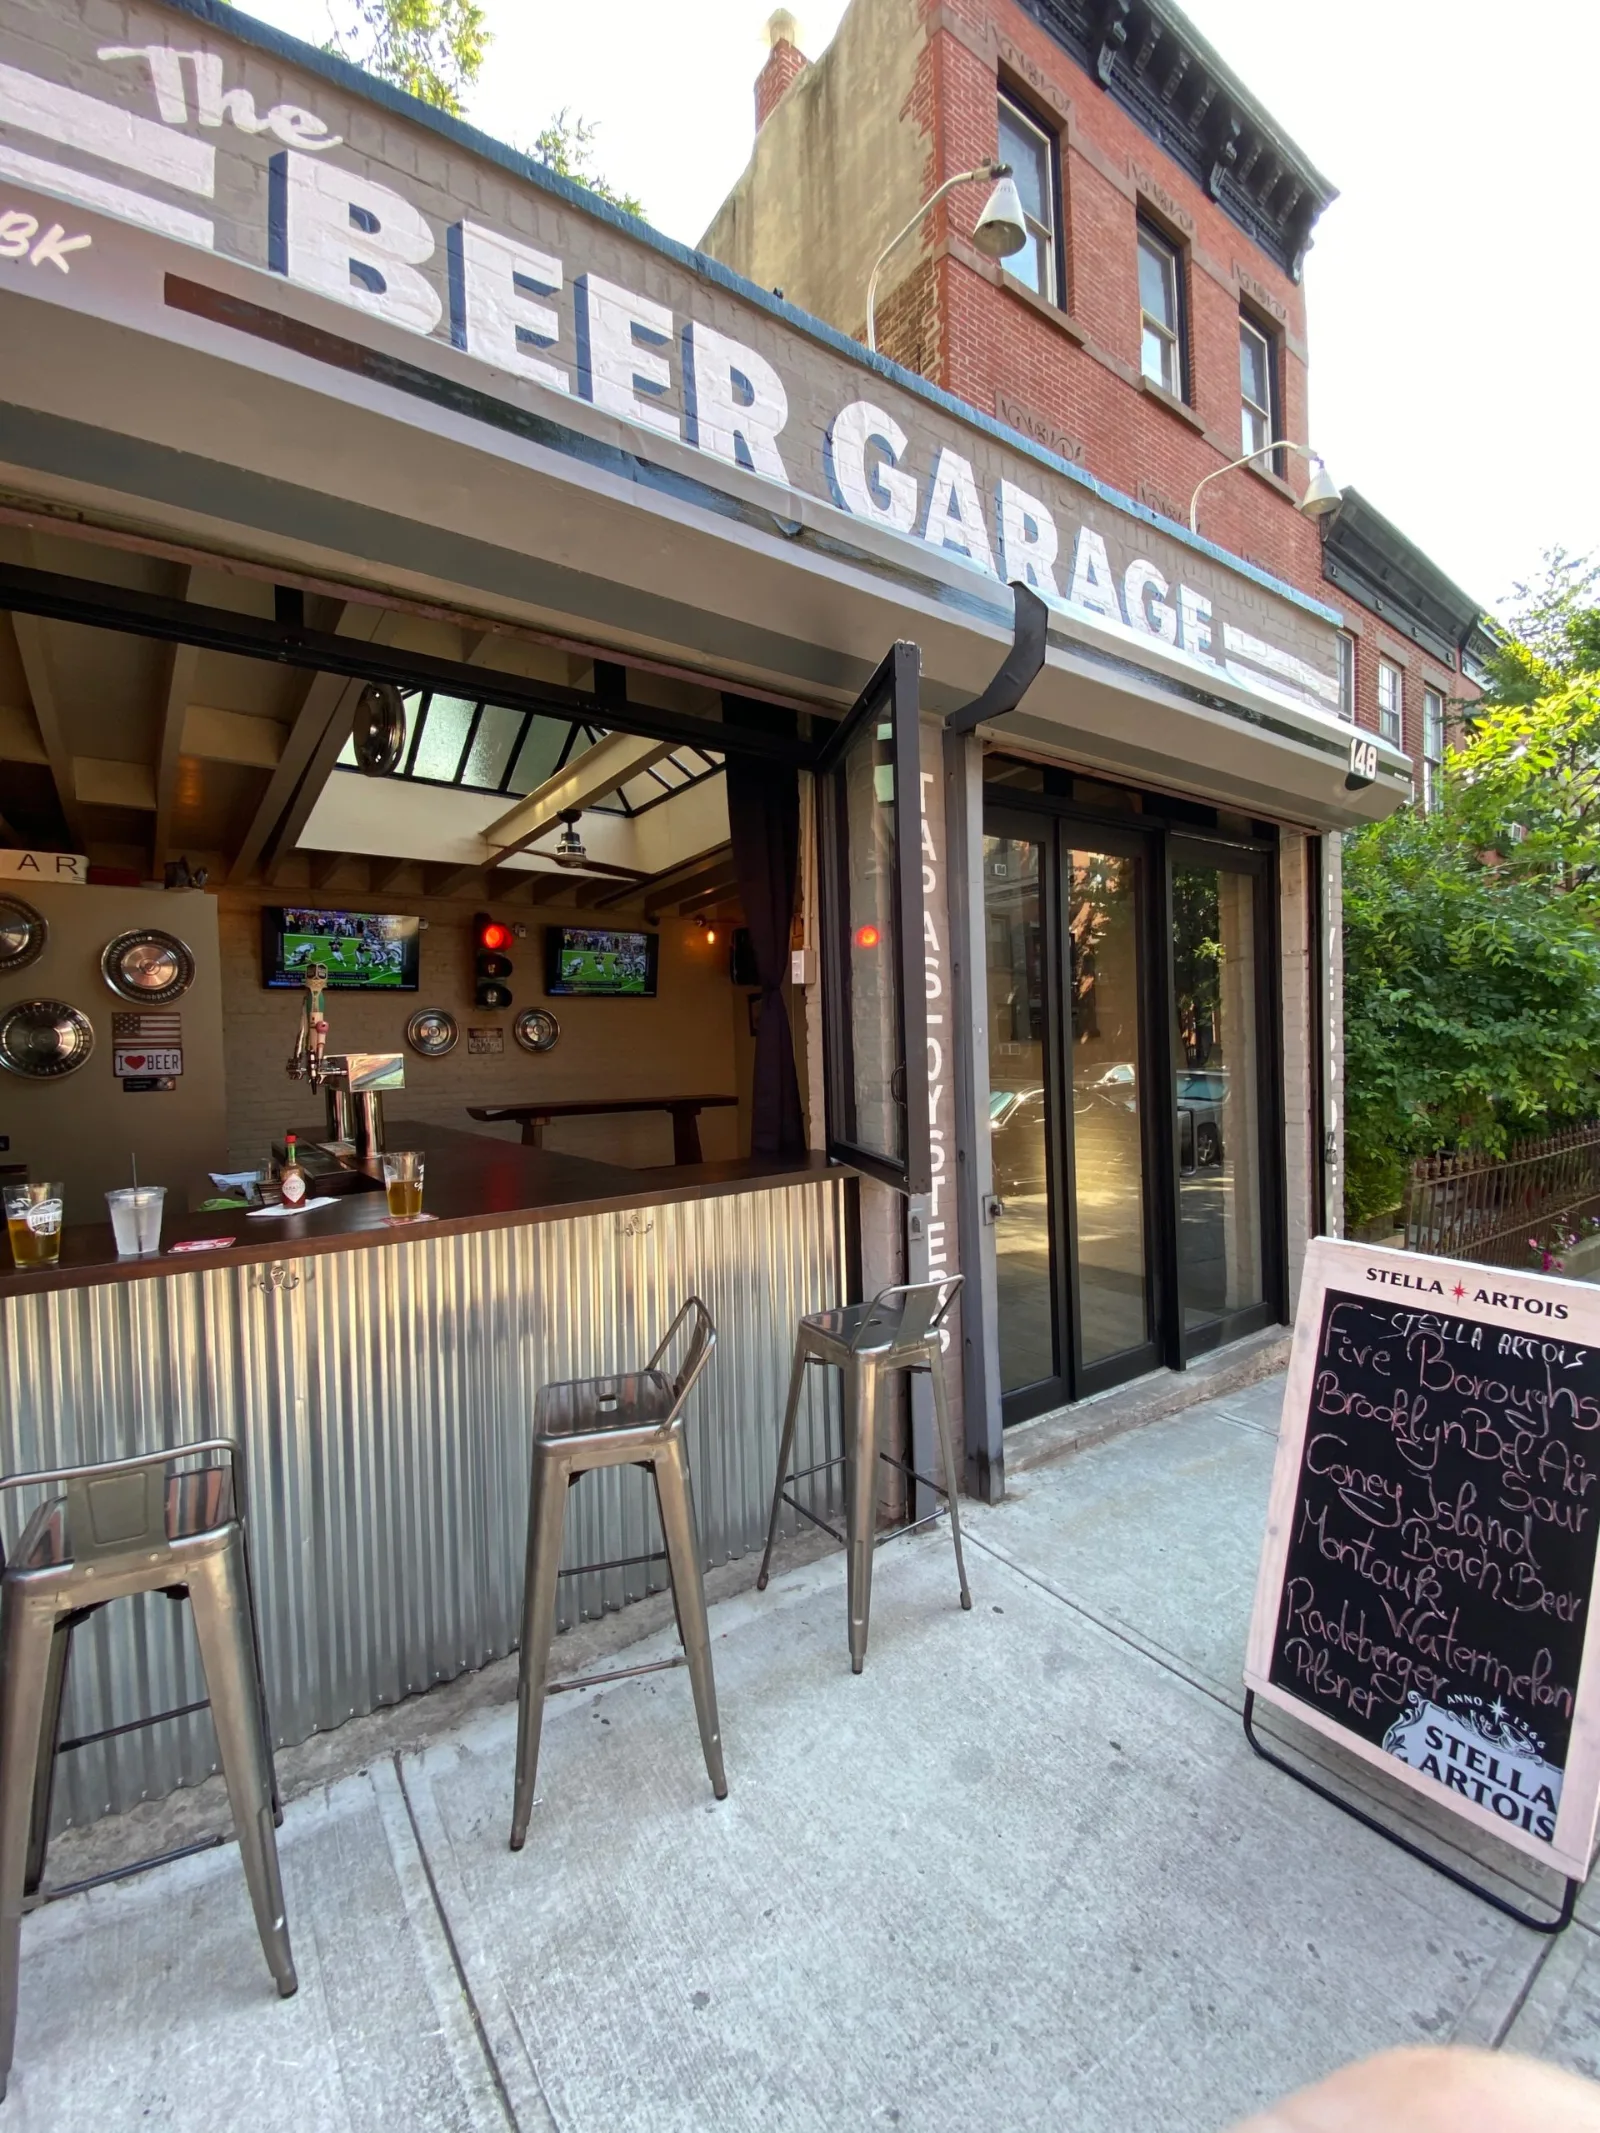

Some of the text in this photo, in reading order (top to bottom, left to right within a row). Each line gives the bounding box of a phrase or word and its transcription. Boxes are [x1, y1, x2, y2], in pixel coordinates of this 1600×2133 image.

[97, 45, 343, 150] The
[269, 149, 1216, 665] BEER GARAGE
[1350, 738, 1377, 780] 148
[118, 1054, 179, 1070] I BEER
[1366, 1268, 1568, 1319] STELLA ARTOIS
[1324, 1302, 1600, 1438] Five Boroughs
[1317, 1370, 1597, 1495] Brooklyn Bel Air
[1306, 1433, 1402, 1528] Coney
[1499, 1470, 1589, 1533] Sour
[1299, 1498, 1448, 1621] Montauk
[1401, 1517, 1582, 1622] Beach Beer
[1284, 1637, 1384, 1719] Pilsner
[1286, 1577, 1450, 1704] Radeberger
[1379, 1594, 1573, 1718] Watermelon
[1446, 1694, 1546, 1749] ANNO 1366
[1419, 1753, 1556, 1843] ARTOIS
[1425, 1725, 1557, 1815] STELLA
